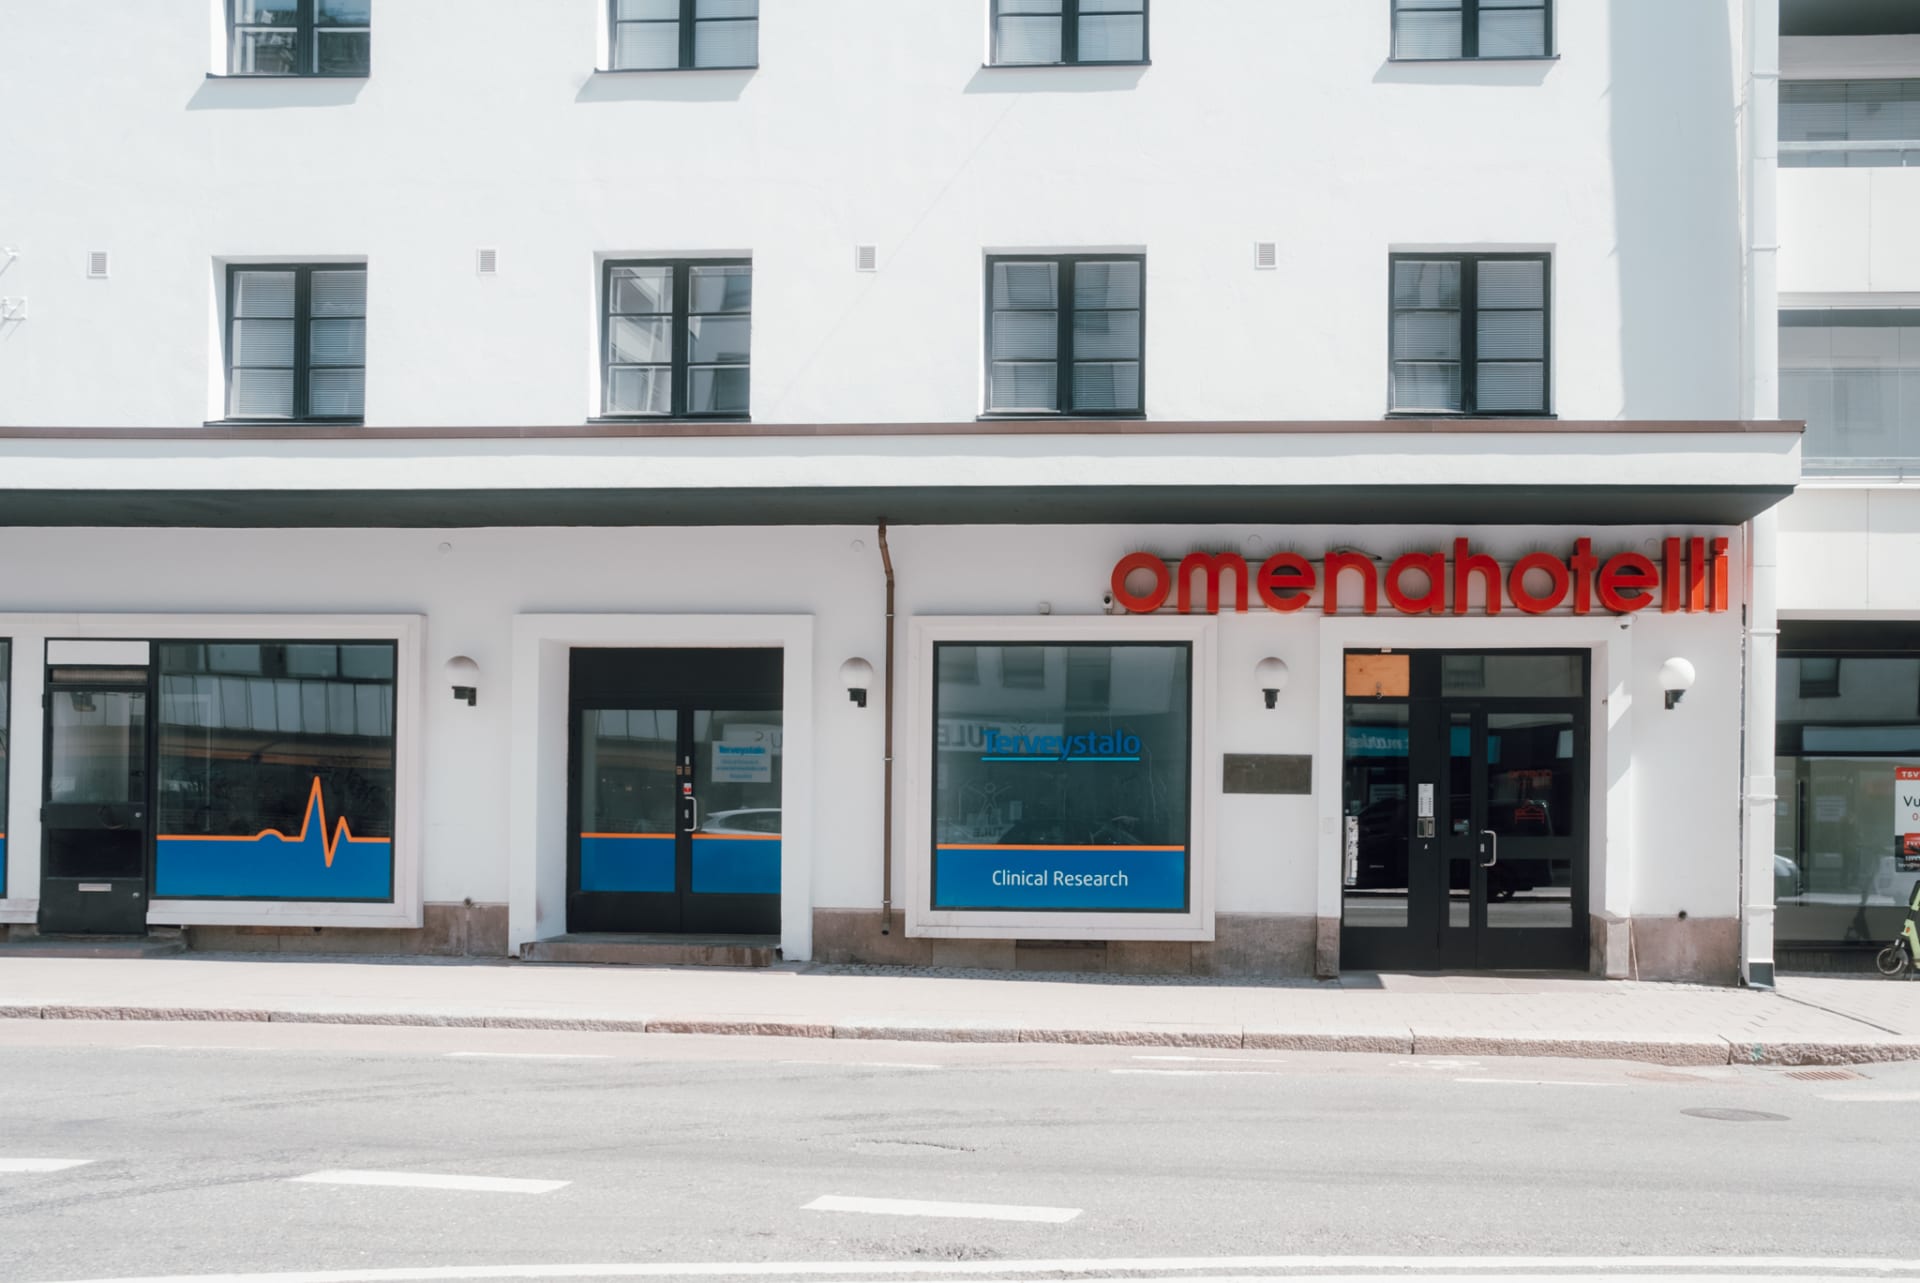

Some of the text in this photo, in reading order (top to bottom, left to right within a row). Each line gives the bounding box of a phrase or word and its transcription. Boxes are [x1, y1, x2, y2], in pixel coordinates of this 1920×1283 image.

[1111, 537, 1728, 614] omenahotelli
[981, 730, 1141, 760] Terveystalo
[992, 870, 1128, 887] Clinical Research
